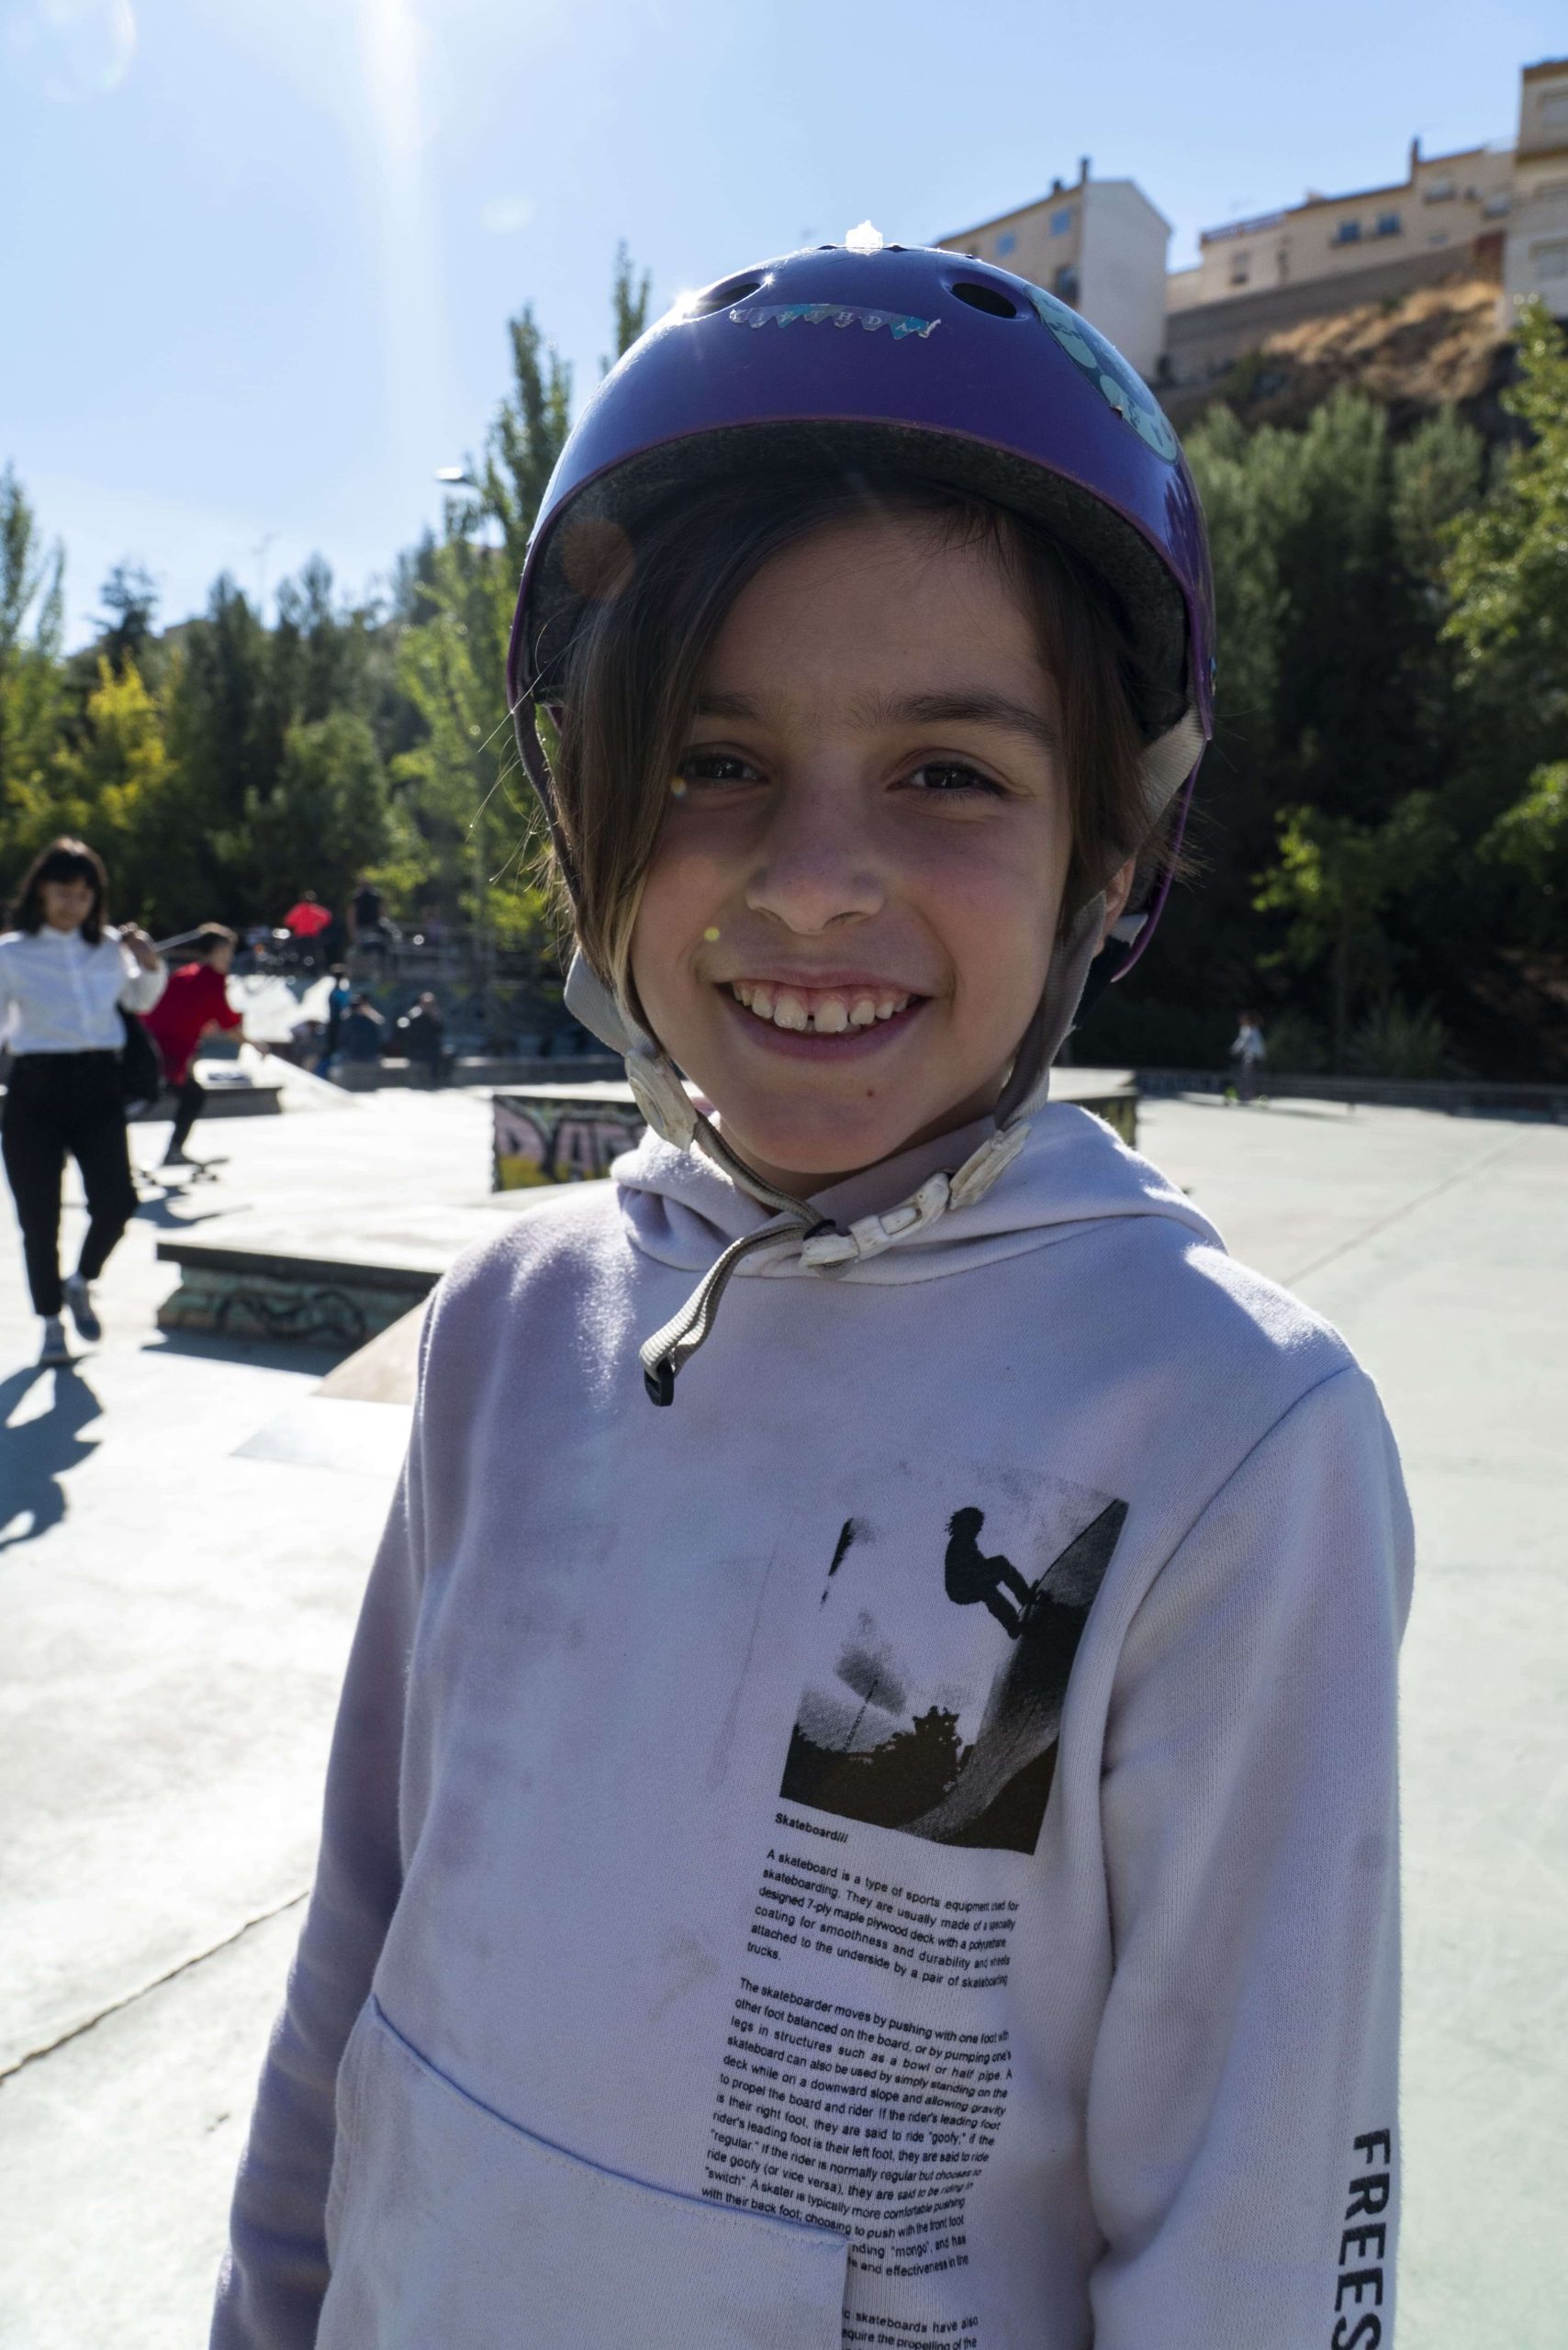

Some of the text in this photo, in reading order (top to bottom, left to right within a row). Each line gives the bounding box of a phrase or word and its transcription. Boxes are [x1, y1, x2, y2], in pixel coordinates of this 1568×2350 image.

[767, 1849, 775, 1860] A
[778, 1853, 838, 1877] skateboard
[842, 1870, 850, 1881] is
[854, 1876, 861, 1885] a
[865, 1877, 888, 1893] type
[891, 1886, 902, 1897] of
[906, 1891, 940, 1908] sports
[945, 1900, 990, 1913] equipment
[1007, 1900, 1020, 1911] for
[758, 1886, 958, 1948] designed 7-ply maple plywood deck with
[846, 1890, 873, 1908] They
[876, 1901, 893, 1913] are
[897, 1908, 937, 1927] usually
[941, 1919, 969, 1930] made
[973, 1920, 981, 1930] of
[751, 1924, 798, 1944] attached
[801, 1936, 811, 1948] to
[815, 1941, 833, 1953] the
[837, 1947, 890, 1969] underside
[894, 1962, 907, 1976] by
[922, 1973, 944, 1984] pair
[947, 1975, 959, 1986] of
[755, 1906, 989, 1971] coating for smoothness and durability and
[735, 1998, 990, 2065] other foot balanced on the or by pumping
[740, 1977, 997, 2043] The skateboarder moves by pushing with one foot
[727, 2036, 785, 2061] skateboard
[786, 2054, 807, 2066] can
[810, 2059, 833, 2072] also
[834, 2062, 848, 2075] be
[879, 2070, 892, 2083] by
[894, 2075, 928, 2089] simply
[931, 2081, 975, 2098] standing
[978, 2087, 991, 2098] on
[992, 2087, 1008, 2098] the
[731, 2016, 975, 2079] legs in structures such as bowl half
[720, 2073, 1001, 2131] to propel the board and the rider's leading foot
[723, 2054, 1006, 2117] deck while on downward slope and allowing gravity
[712, 2111, 745, 2129] rider's
[747, 2121, 787, 2143] leading
[790, 2132, 811, 2147] foot
[813, 2138, 823, 2150] is
[825, 2142, 850, 2155] their
[852, 2145, 869, 2157] left
[898, 2150, 920, 2165] they
[923, 2152, 937, 2162] are
[940, 2152, 960, 2162] said
[970, 2152, 989, 2163] ride
[729, 2096, 753, 2112] their
[756, 2105, 781, 2120] right
[814, 2120, 838, 2135] they
[842, 2125, 860, 2136] are
[865, 2128, 888, 2140] said
[892, 2131, 902, 2141] to
[906, 2131, 924, 2143] ride
[979, 2134, 994, 2146] the
[707, 2149, 939, 2200] ride goofy (or vice they are said be
[771, 2147, 789, 2160] the
[790, 2153, 815, 2166] rider
[830, 2163, 878, 2182] normally
[880, 2170, 917, 2184] regular
[919, 2171, 934, 2181] but
[701, 2187, 722, 2200] with
[725, 2192, 749, 2206] their
[751, 2199, 776, 2214] back
[805, 2212, 852, 2235] choosing
[855, 2226, 865, 2237] to
[867, 2228, 895, 2240] push
[898, 2224, 915, 2237] with
[916, 2221, 928, 2233] the
[930, 2218, 947, 2231] front
[948, 2214, 964, 2226] foot
[761, 2182, 966, 2220] skater typically more comfortable pushing
[860, 2254, 969, 2277] and effectiveness the
[935, 2234, 967, 2251] and has
[856, 2311, 979, 2333] skateboards have also
[878, 2333, 977, 2348] the the
